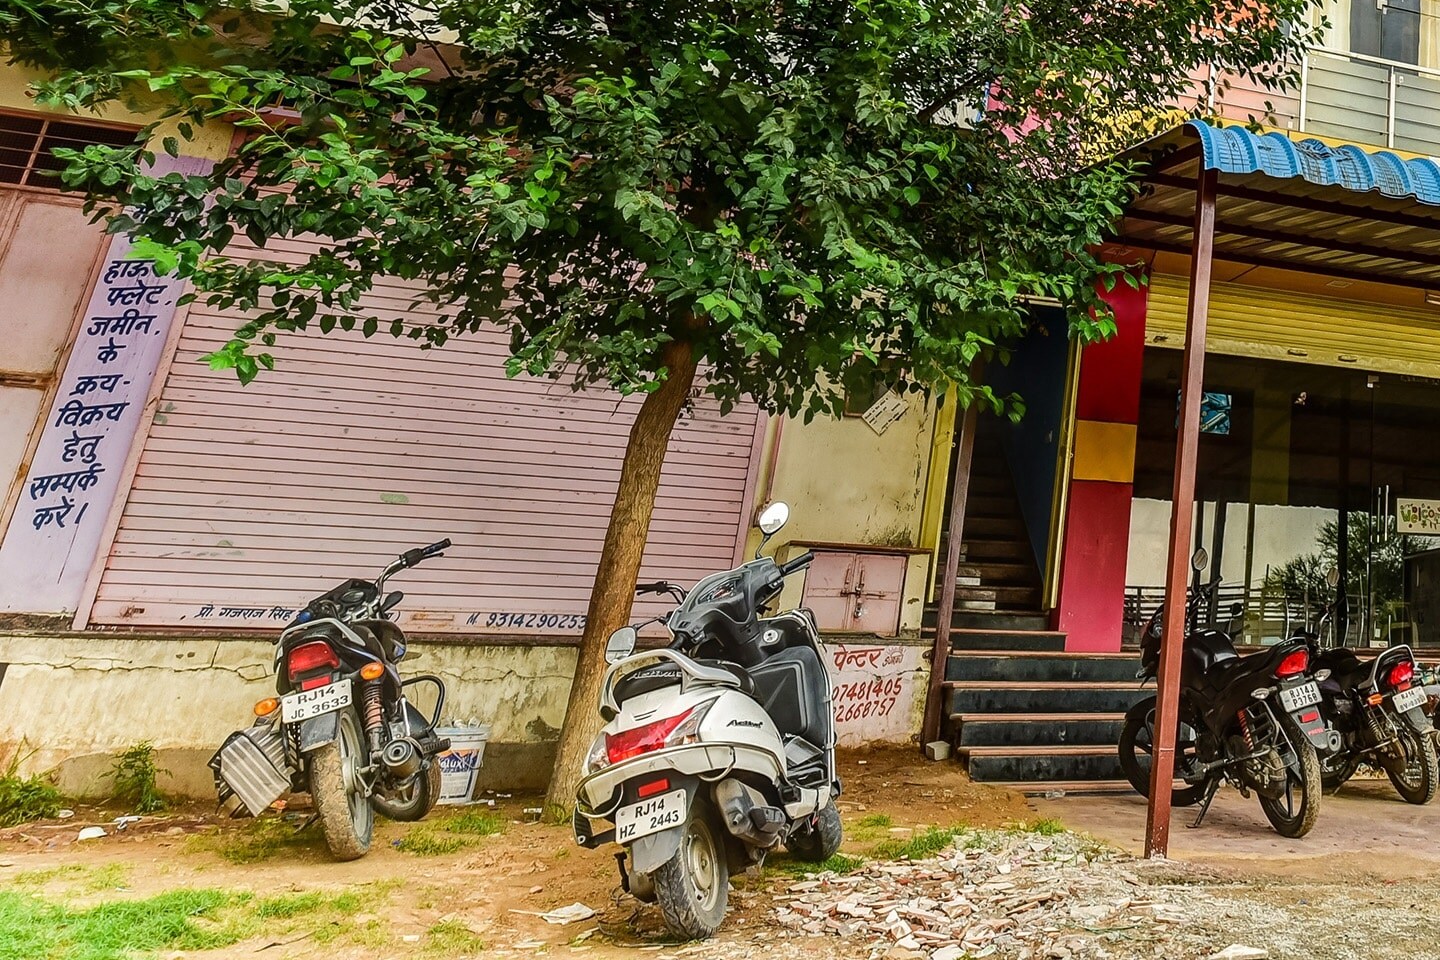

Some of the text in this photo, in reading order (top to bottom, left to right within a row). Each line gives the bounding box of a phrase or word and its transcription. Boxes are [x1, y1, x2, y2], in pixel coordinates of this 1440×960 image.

[97, 337, 127, 364] के
[54, 399, 131, 428] विक्रय
[61, 430, 105, 464] हेतु
[29, 462, 106, 501] सम्पर्क
[218, 606, 266, 620] गजराज
[268, 605, 293, 621] सिंह
[290, 694, 349, 720] JC 3633
[297, 685, 336, 704] RJ14
[635, 798, 665, 819] RJ14
[619, 823, 636, 839] HZ
